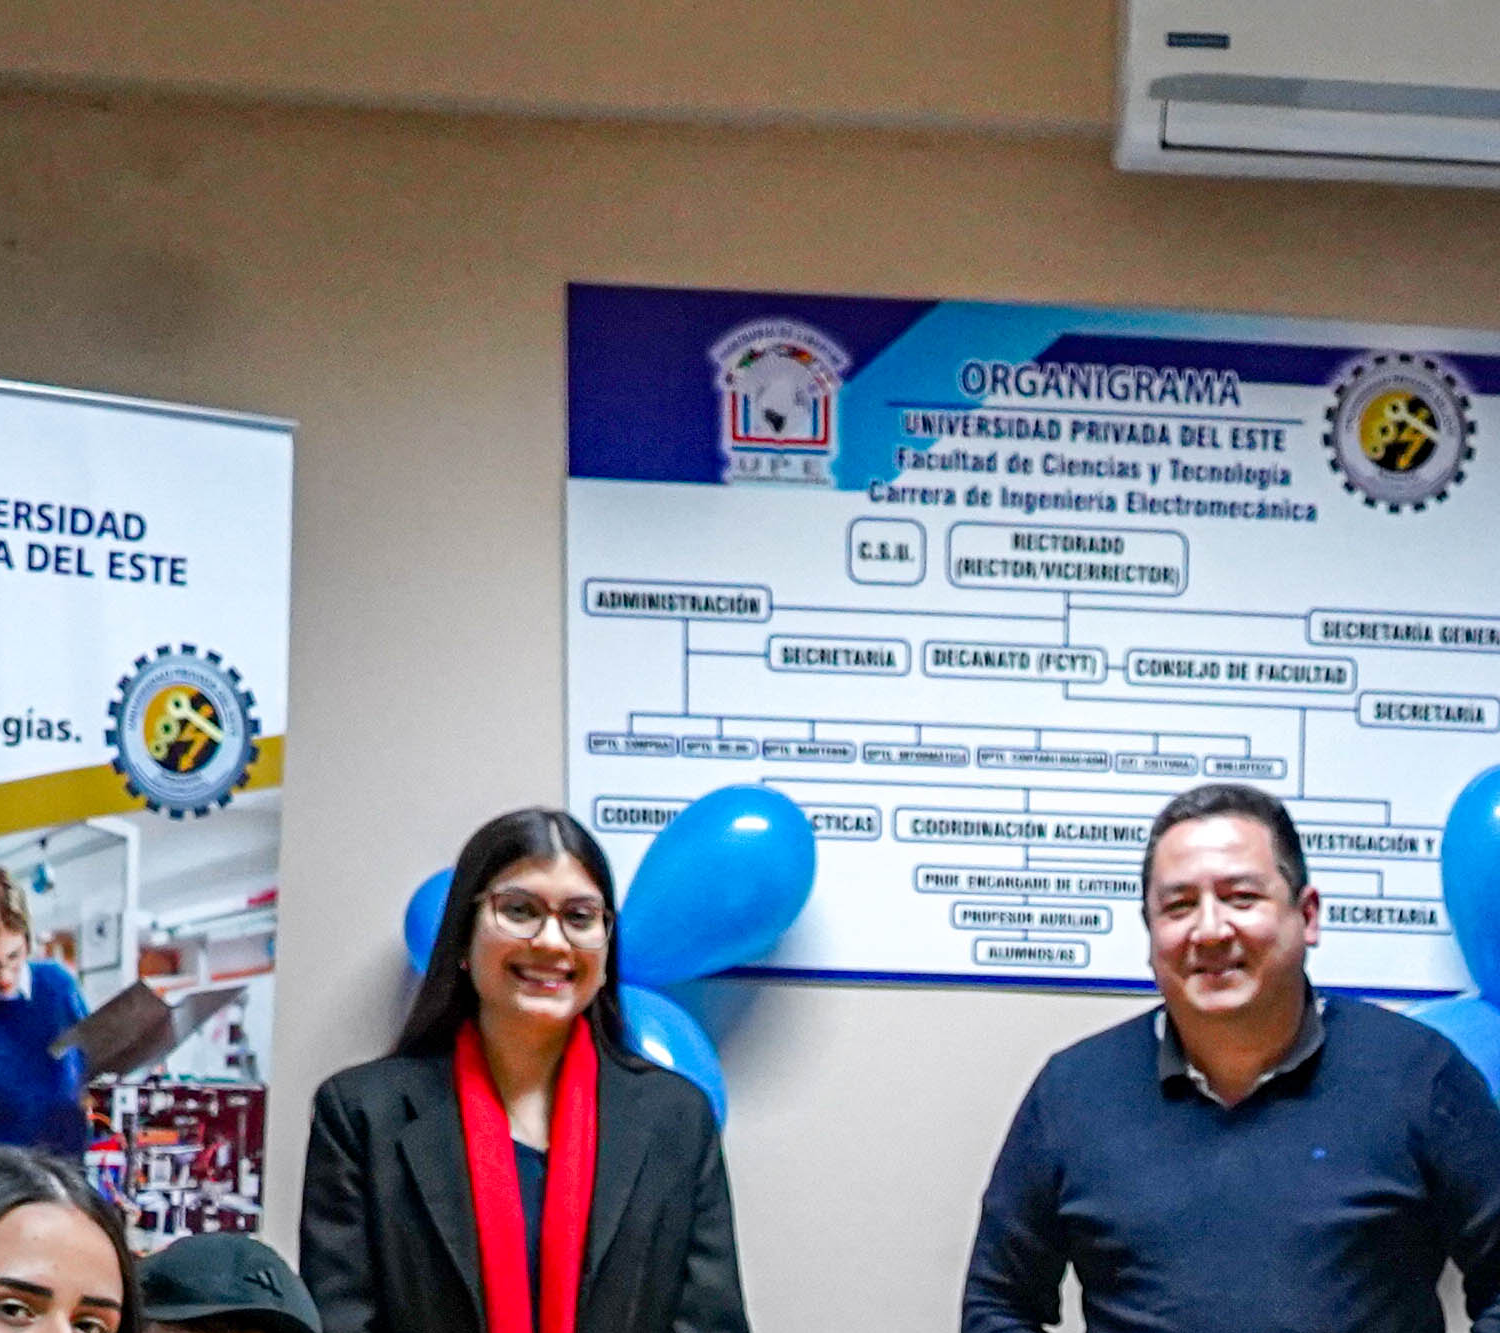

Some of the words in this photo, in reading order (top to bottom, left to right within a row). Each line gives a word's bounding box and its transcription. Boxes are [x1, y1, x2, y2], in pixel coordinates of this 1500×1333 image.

[960, 362, 1241, 407] ORGANIGRAMA
[905, 412, 1061, 442] UNIVERSIDAD
[1071, 421, 1170, 447] PRIVADA
[1181, 425, 1222, 449] DEL
[1232, 428, 1286, 452] ESTE
[899, 447, 997, 474] Facultad
[1006, 450, 1033, 475] de
[1042, 453, 1141, 479] Ciencias
[1151, 464, 1162, 486] y
[1170, 456, 1292, 490] Tecnología
[868, 480, 956, 506] Carrera
[966, 482, 992, 507] de
[1001, 484, 1117, 514] Ingeniería
[1126, 491, 1318, 522] Electromecánica
[1011, 532, 1125, 555] RECTORADO
[26, 542, 95, 578] DEL
[108, 551, 188, 586] ESTE
[956, 558, 1181, 584] (RECTOR/VICERRECTOR)
[596, 589, 761, 614] ADMINISTRACIÓN
[1322, 620, 1433, 643] SECRETARÍA
[782, 645, 897, 668] SECRETARÍA
[932, 649, 1030, 671] DECANATO
[1037, 650, 1098, 676] (FCYT)
[1134, 658, 1219, 680] CONSEJO
[1227, 662, 1249, 681] DE
[1255, 660, 1347, 685] FACULTAD
[1373, 701, 1485, 724] SECRETARÍA
[911, 816, 1047, 840] COORDINACIÓN
[1053, 821, 1149, 843] ACADEMIC
[1426, 839, 1436, 853] Y
[1057, 878, 1073, 891] DE
[963, 909, 1034, 925] PROFESOR
[1327, 904, 1438, 927] SECRETARÍA
